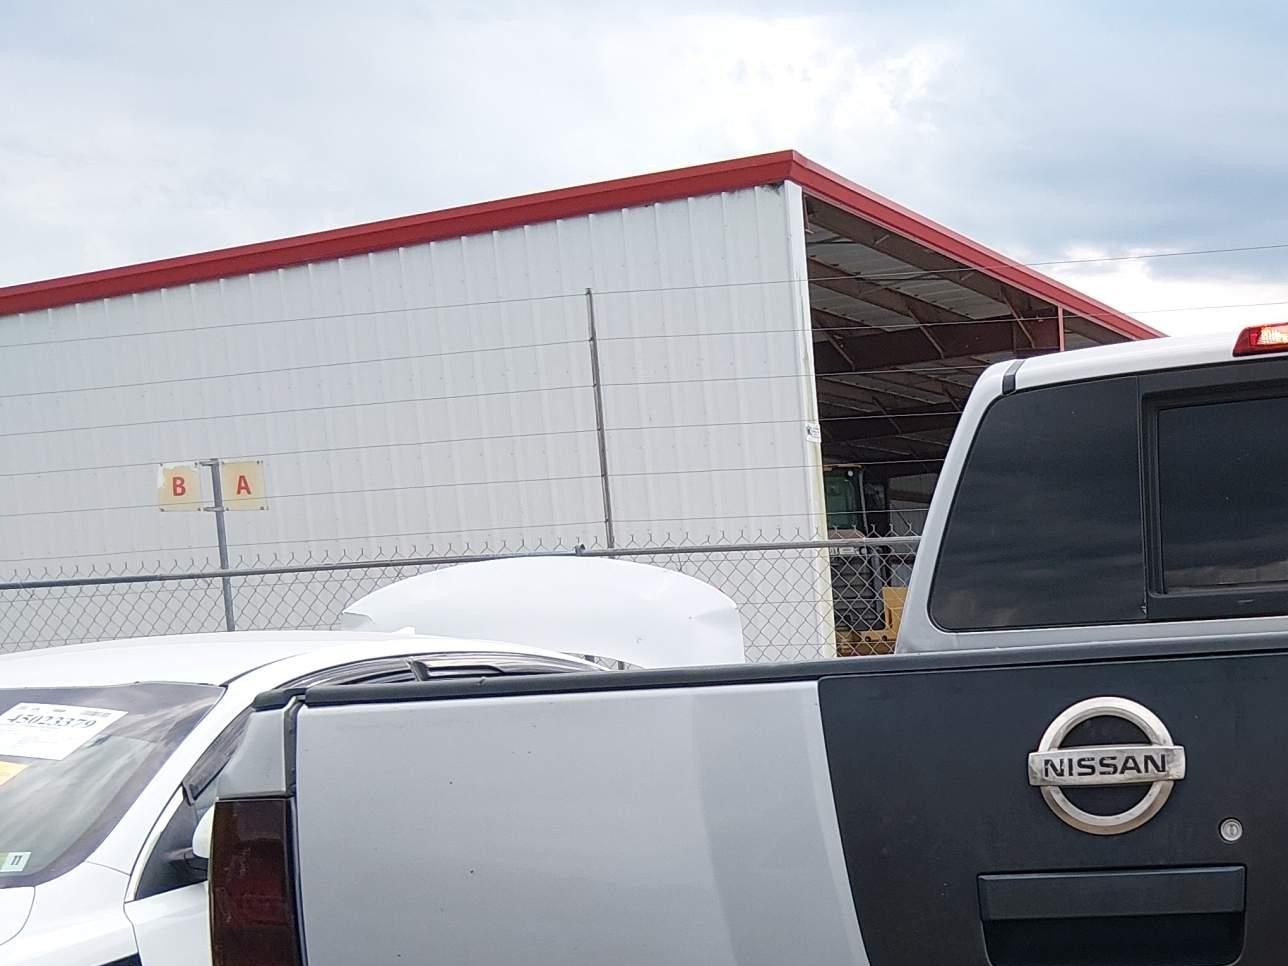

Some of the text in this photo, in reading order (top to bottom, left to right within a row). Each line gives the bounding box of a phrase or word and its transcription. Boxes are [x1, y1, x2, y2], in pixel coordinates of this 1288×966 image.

[172, 476, 187, 497] B
[236, 475, 252, 496] A
[1044, 753, 1167, 778] NISSAN
